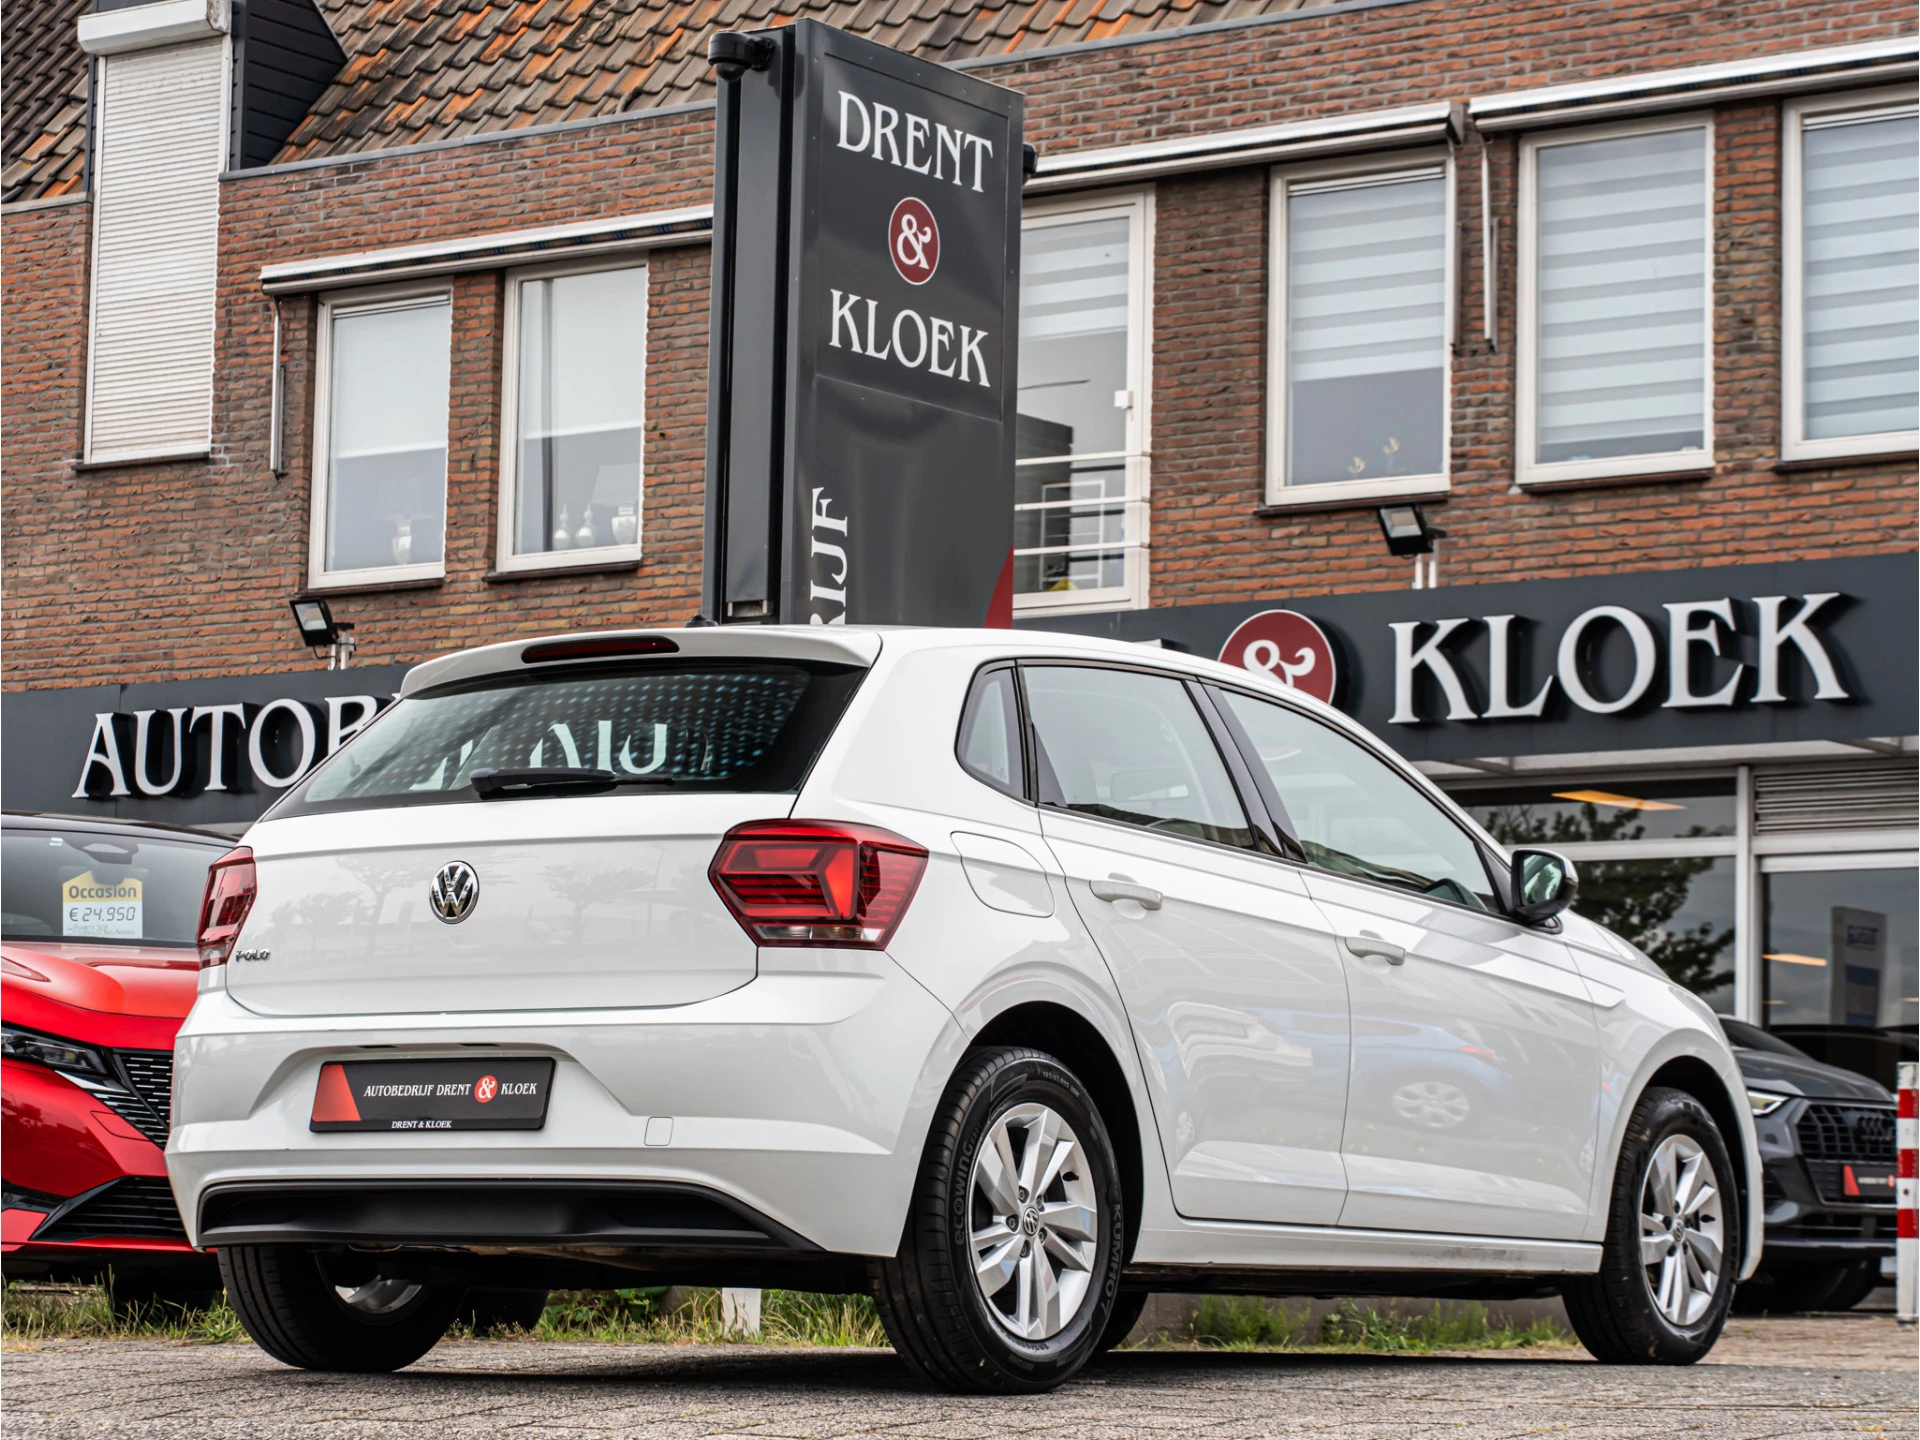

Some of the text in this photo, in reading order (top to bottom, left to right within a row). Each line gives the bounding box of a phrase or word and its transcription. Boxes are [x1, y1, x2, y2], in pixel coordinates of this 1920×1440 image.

[837, 90, 993, 193] DRENT
[897, 213, 932, 270] &
[829, 288, 991, 388] KLOEK
[1387, 591, 1850, 723] KLOEK
[68, 885, 137, 899] Occasion
[235, 949, 271, 963] POLO
[363, 1077, 537, 1099] AUTOBEDRIJF DRENT & KLOEK
[391, 1120, 418, 1129] DRENT
[425, 1120, 452, 1129] KLOEK
[1105, 1203, 1122, 1298] KUMHO
